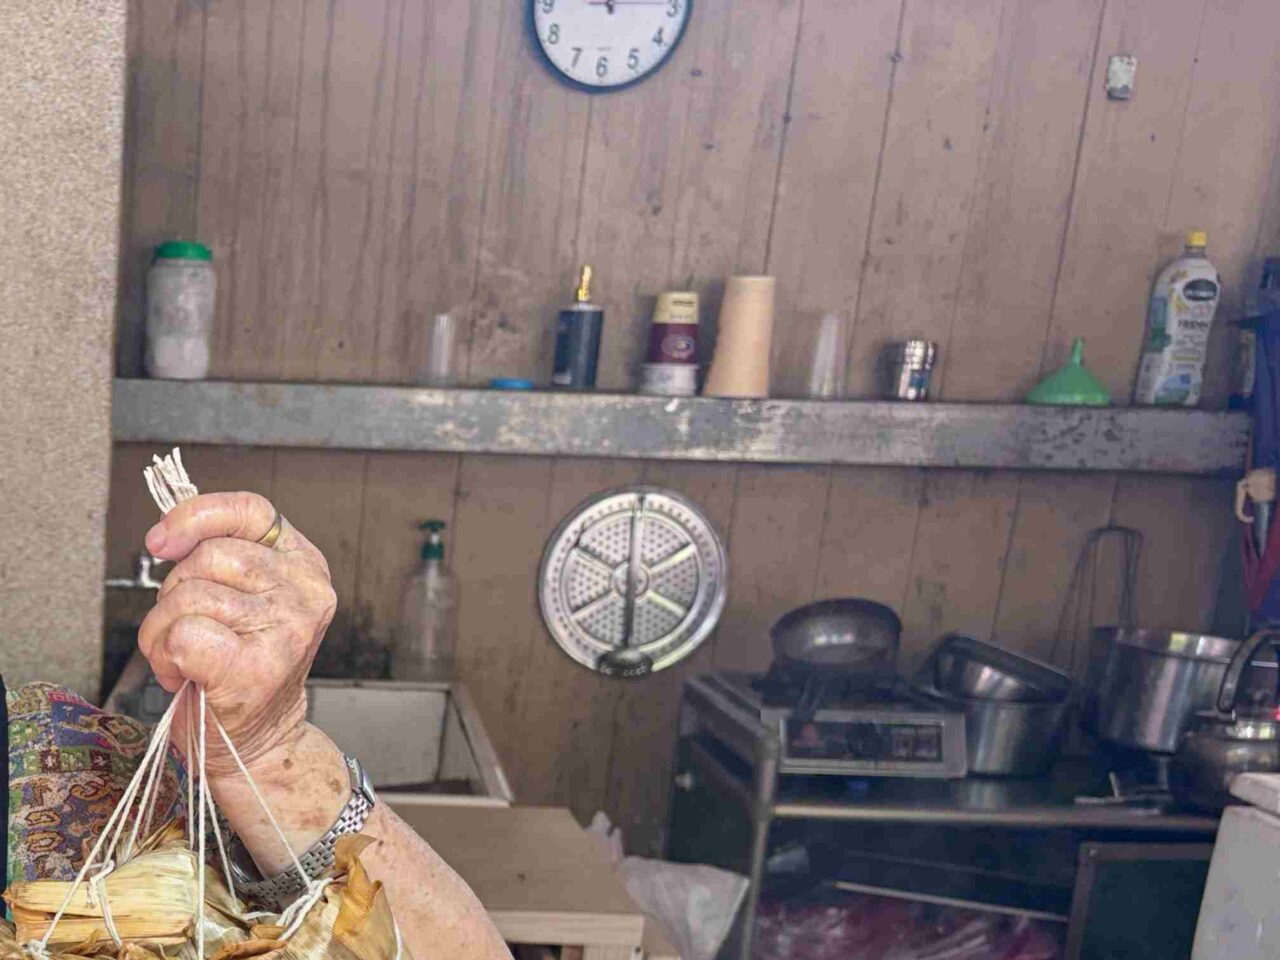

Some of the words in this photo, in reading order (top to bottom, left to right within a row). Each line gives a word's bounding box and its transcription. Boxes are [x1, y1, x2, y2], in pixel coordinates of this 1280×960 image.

[547, 23, 560, 45] 8
[652, 27, 665, 46] 4
[570, 47, 582, 68] 7
[595, 57, 609, 78] 6
[626, 48, 640, 70] 5
